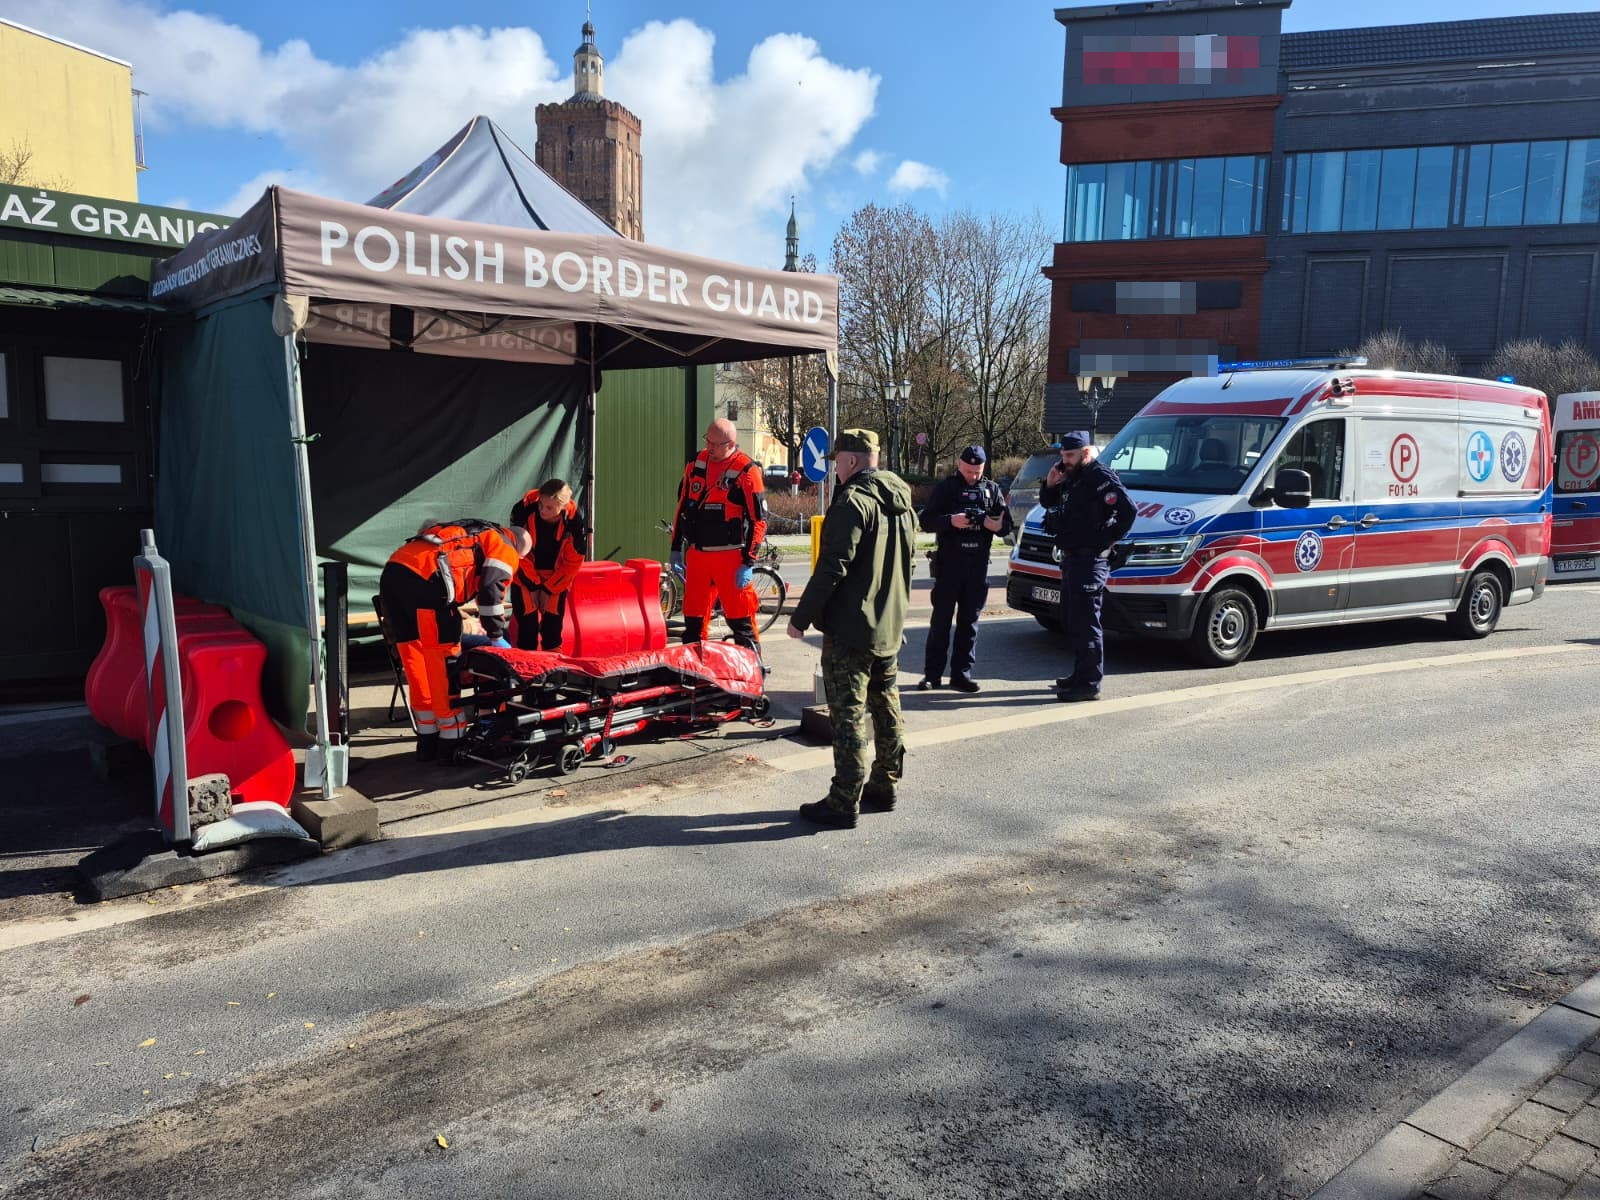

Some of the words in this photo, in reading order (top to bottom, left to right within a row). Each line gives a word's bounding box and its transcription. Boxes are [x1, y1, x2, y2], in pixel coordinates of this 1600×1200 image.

[70, 203, 231, 244] GRANI
[209, 232, 262, 269] GRANICZNEJ
[320, 220, 504, 285] POLISH
[524, 246, 689, 306] BORDER
[702, 274, 824, 325] GUARD
[1399, 444, 1412, 473] P
[1577, 444, 1592, 470] P
[1388, 484, 1405, 497] F01
[1407, 484, 1419, 497] 34
